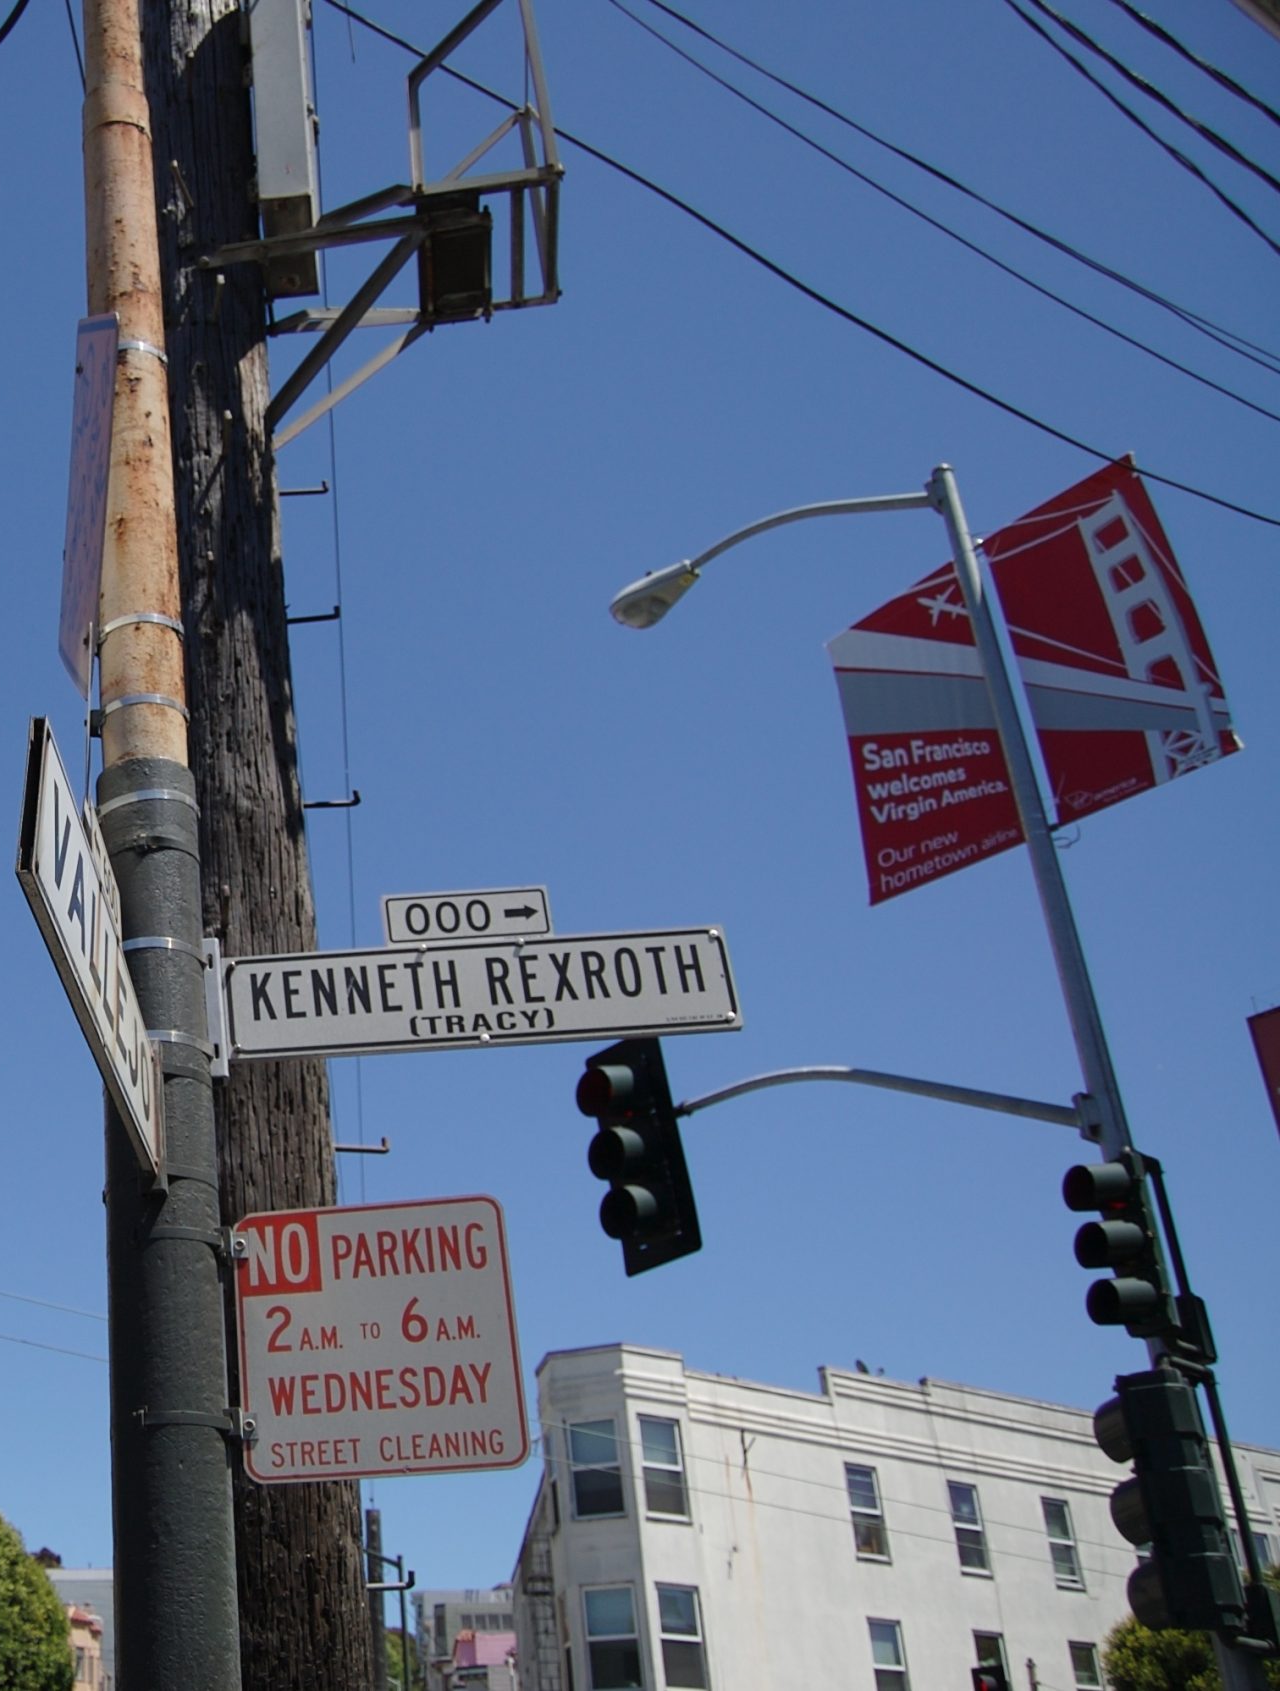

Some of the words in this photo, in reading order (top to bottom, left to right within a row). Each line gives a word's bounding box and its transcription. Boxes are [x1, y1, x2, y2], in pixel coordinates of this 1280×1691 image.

[862, 742, 908, 771] San
[910, 738, 991, 764] Francisco
[867, 767, 967, 800] welcomes
[871, 796, 937, 824] Virgin
[941, 780, 1008, 807] America.
[878, 844, 916, 868] Our
[920, 831, 959, 854] new
[880, 844, 978, 893] hometown
[53, 777, 151, 1122] VALLEJO
[250, 958, 462, 1022] KENNETH
[486, 943, 706, 1006] REXROTH
[409, 1007, 555, 1037] (TRACY)
[247, 1222, 311, 1288] NO
[331, 1222, 488, 1281] PARKING
[360, 1322, 381, 1340] TO
[268, 1362, 492, 1417] WEDNESDAY
[271, 1438, 361, 1469] STREET
[379, 1429, 505, 1462] CLEANING
